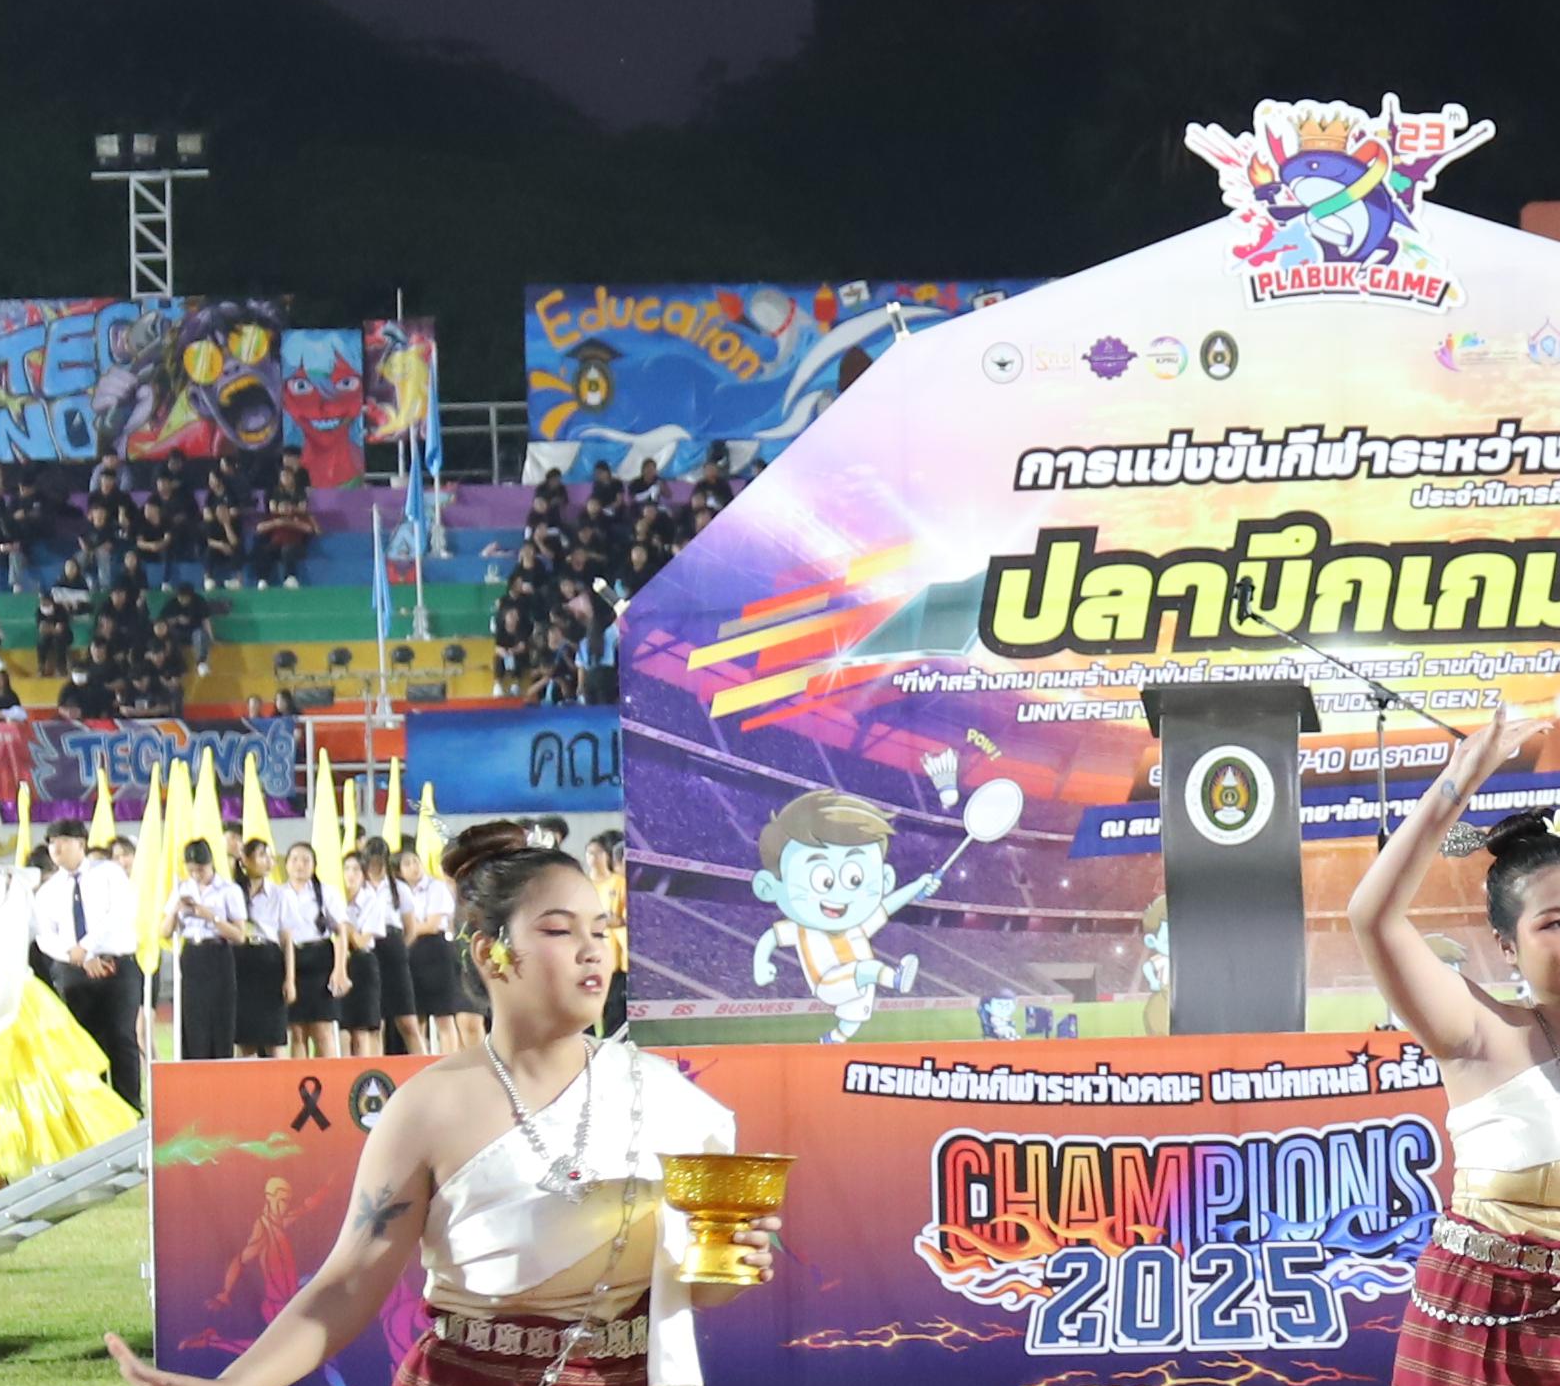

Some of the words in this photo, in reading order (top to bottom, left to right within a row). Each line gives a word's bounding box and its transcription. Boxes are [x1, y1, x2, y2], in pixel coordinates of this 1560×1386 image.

[1257, 265, 1356, 296] PLABUK
[1368, 266, 1443, 299] GAME
[535, 285, 760, 381] Education
[1430, 689, 1479, 710] GEN
[965, 727, 1002, 762] POW!
[715, 1001, 794, 1014] BUSINESS
[844, 1058, 1202, 1104] การแข่งขันกีฬาระหว่างคณะ
[943, 1120, 1432, 1251] CHAMPIONS
[1038, 1245, 1342, 1347] 2025
